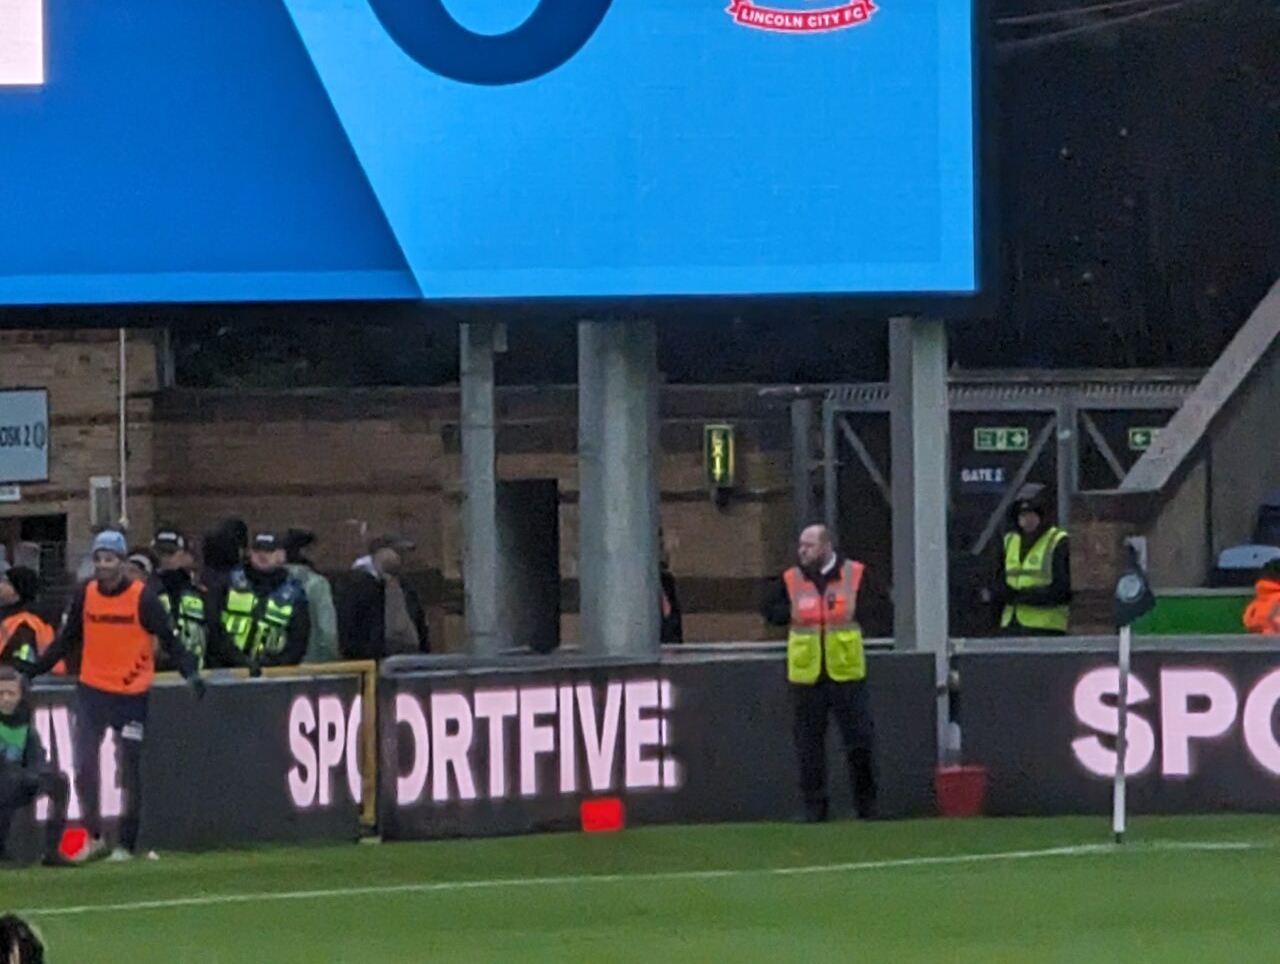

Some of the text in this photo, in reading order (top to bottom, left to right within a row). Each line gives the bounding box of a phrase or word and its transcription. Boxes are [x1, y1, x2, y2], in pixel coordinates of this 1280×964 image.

[741, 6, 863, 28] LINCOLN CITY FC
